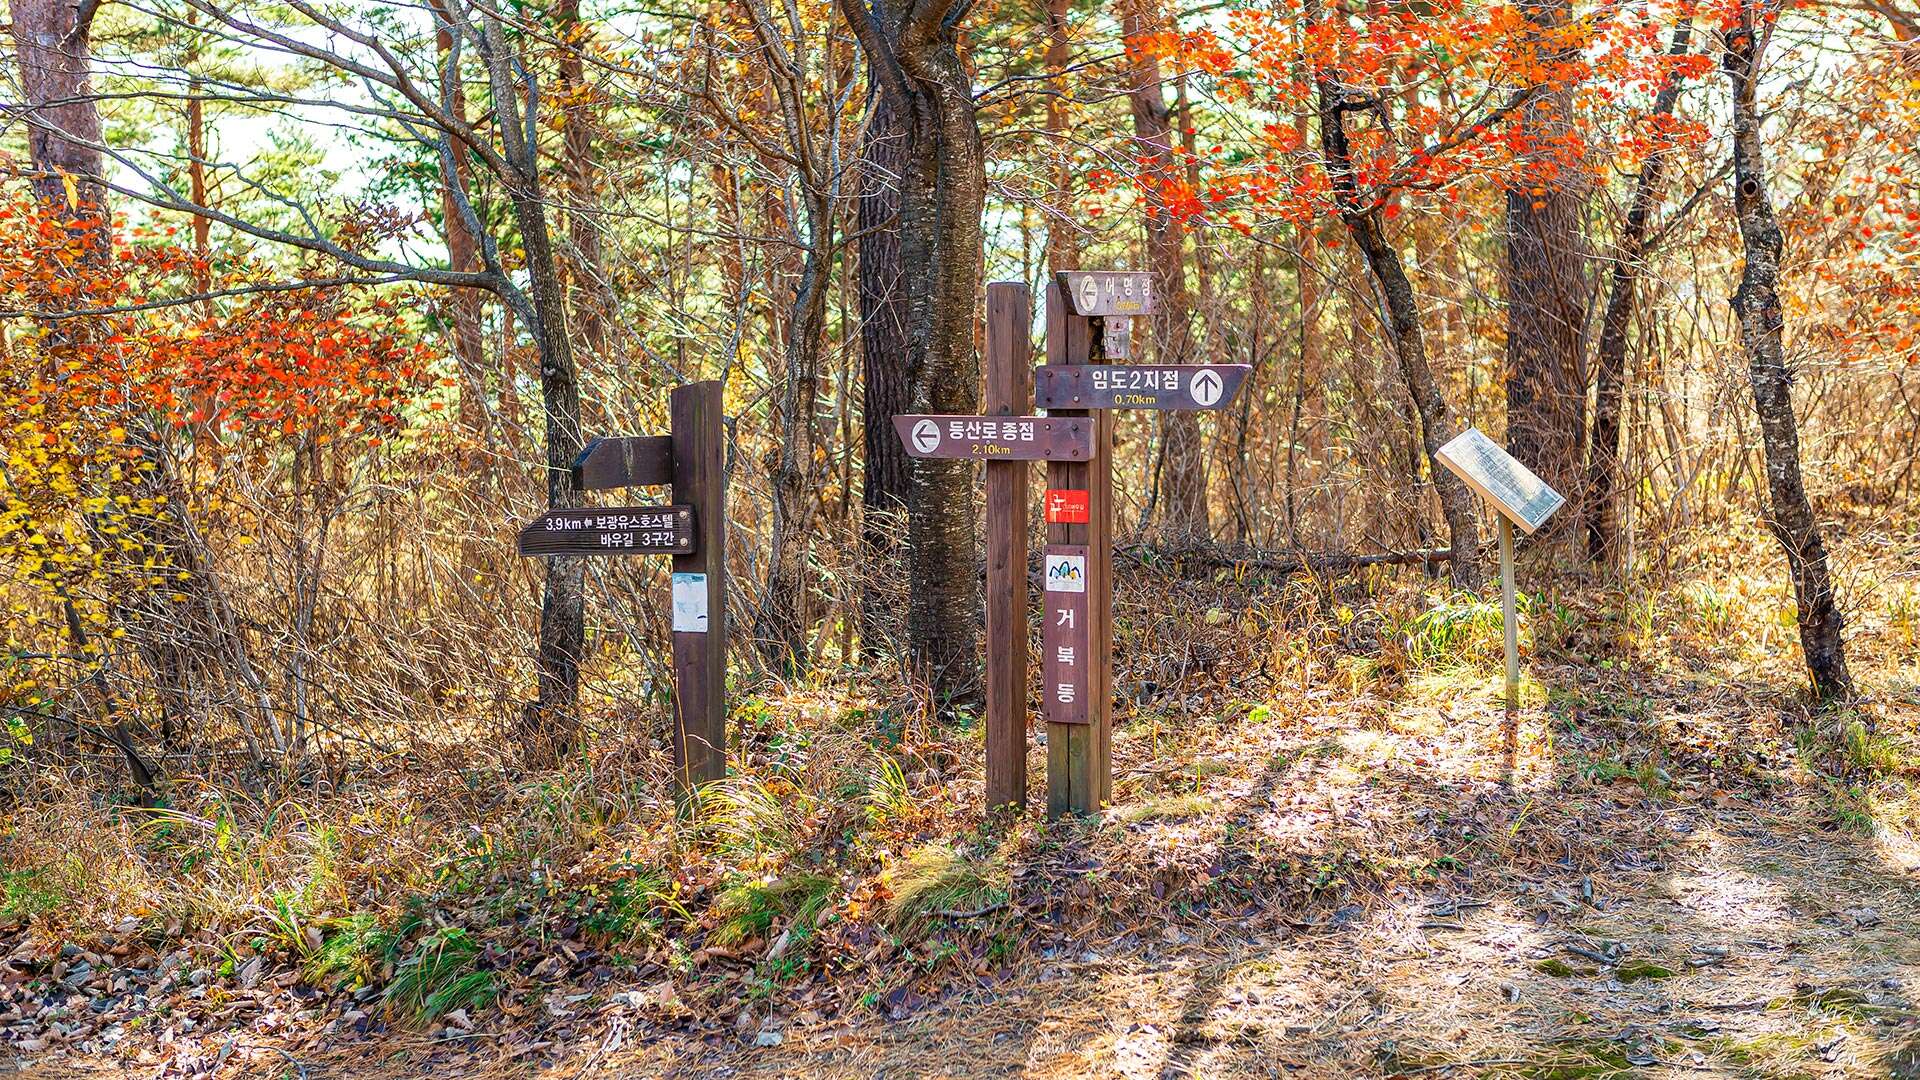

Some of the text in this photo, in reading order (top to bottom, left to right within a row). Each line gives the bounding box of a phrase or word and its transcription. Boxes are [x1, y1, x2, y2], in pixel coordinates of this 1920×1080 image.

[1092, 370, 1179, 390] 임도2지점
[1114, 394, 1156, 405] 0.70km
[949, 421, 1034, 441] 등산로 종점
[971, 444, 1011, 455] 2.10km
[546, 514, 673, 531] 3.9km 보광유스호스텔
[600, 532, 675, 547] 바우길 3구간
